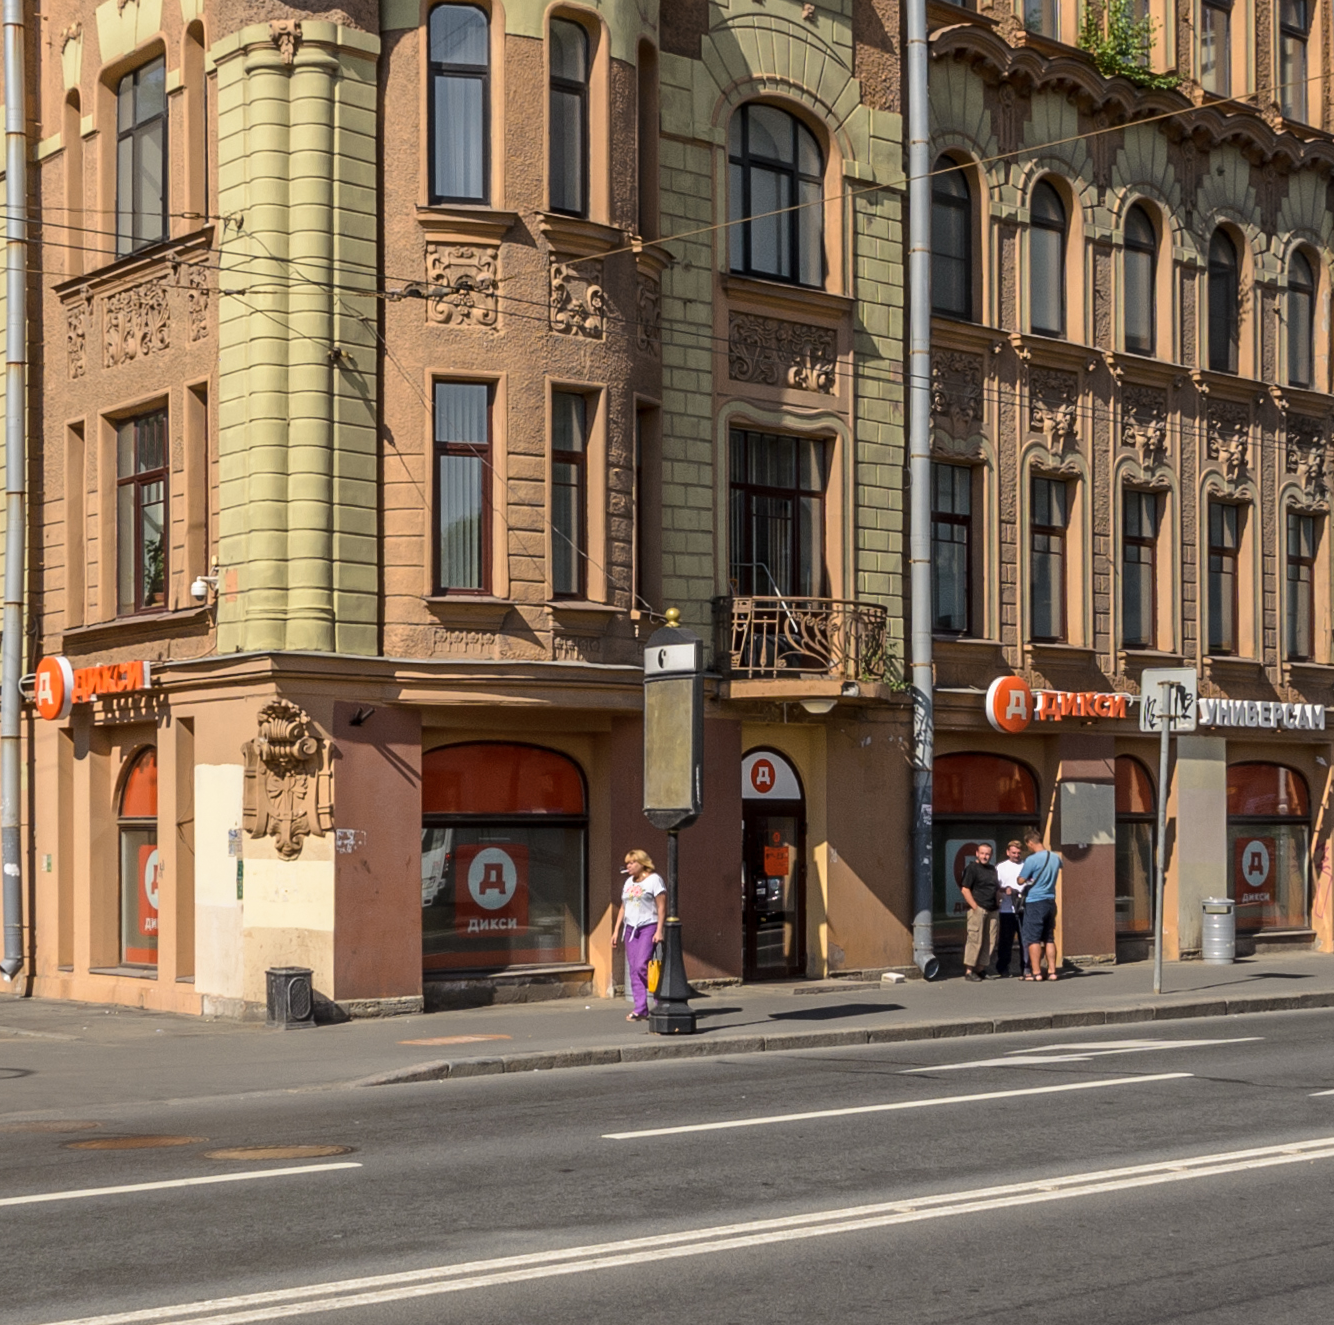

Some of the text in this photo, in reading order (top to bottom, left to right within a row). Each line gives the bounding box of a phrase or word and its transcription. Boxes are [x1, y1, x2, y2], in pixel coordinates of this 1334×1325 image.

[37, 661, 148, 706] Д ДИКСИ
[1006, 690, 1027, 720] Д
[1038, 691, 1126, 721] ДИКСИ
[1200, 698, 1325, 730] УНИВЕРСАМ
[756, 766, 771, 785] Д
[1248, 852, 1264, 876] Д
[479, 863, 506, 895] Д
[467, 918, 517, 933] ДИКСИ
